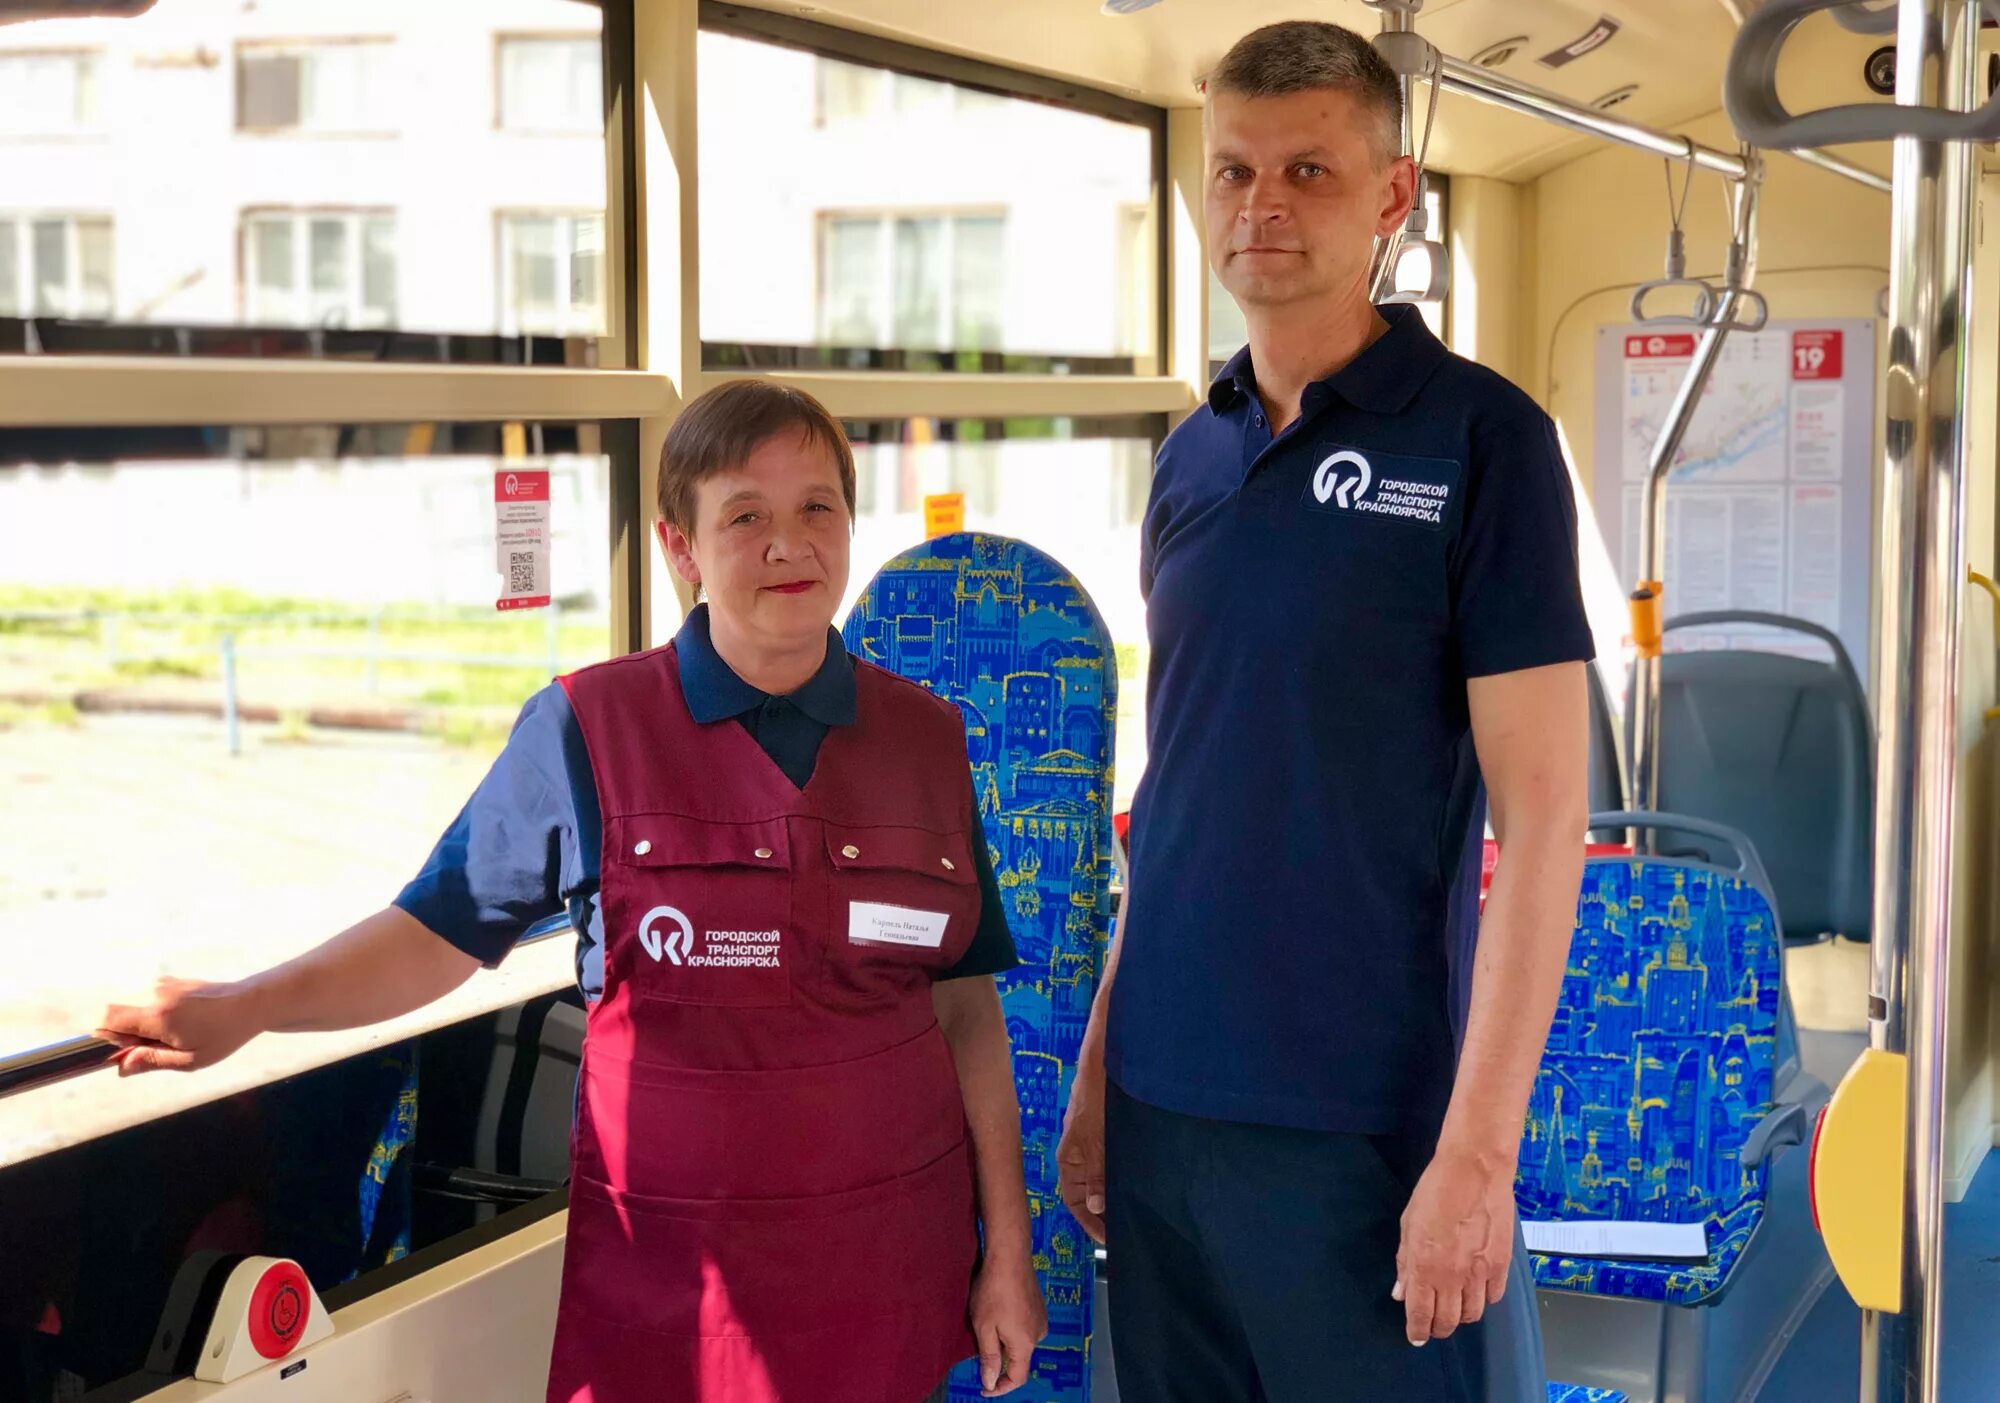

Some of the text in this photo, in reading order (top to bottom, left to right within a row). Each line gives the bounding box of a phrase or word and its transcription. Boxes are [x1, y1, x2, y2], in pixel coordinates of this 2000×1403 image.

[1795, 346, 1825, 370] 19
[1379, 478, 1449, 498] ГОРОДСКОЙ
[1376, 492, 1446, 511] ТРАНСПОРТ
[1354, 500, 1441, 523] КРАСНОЯРСКА
[902, 921, 929, 932] Наталья
[705, 929, 780, 943] ГОРОДСКОЙ
[706, 943, 780, 956] ТРАНСПОРТ
[687, 955, 780, 968] КРАСНОЯРСКА
